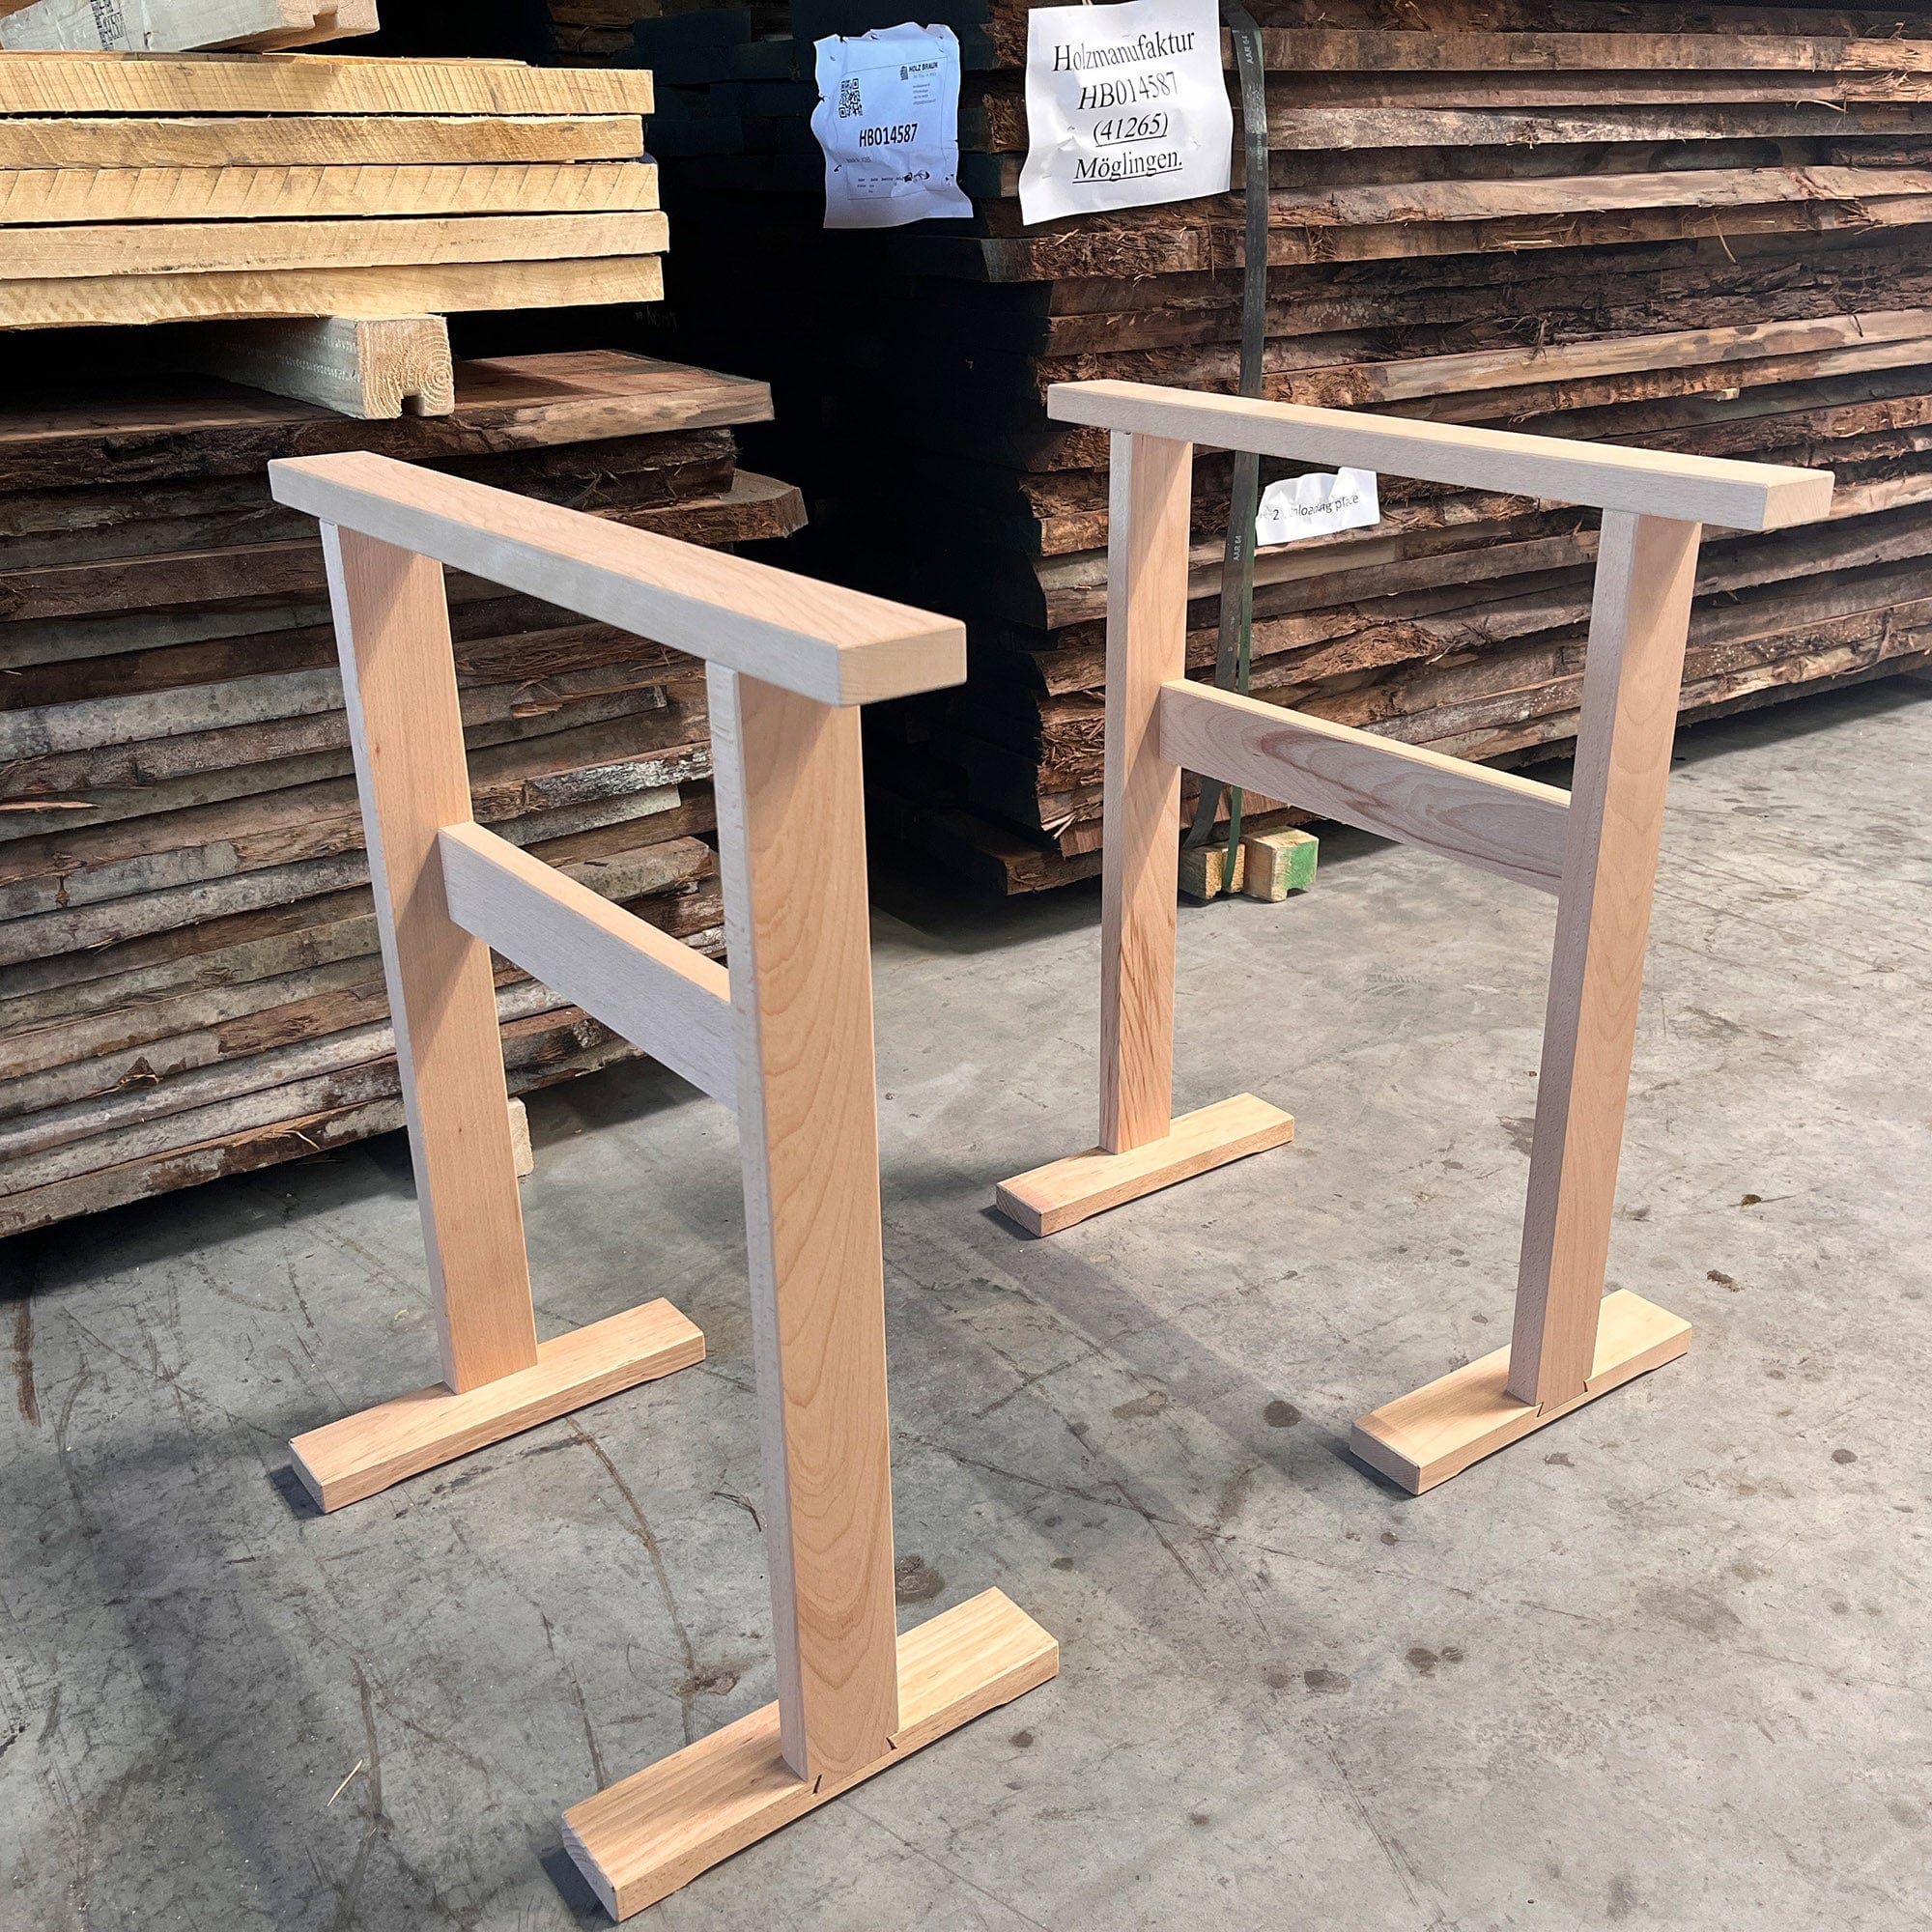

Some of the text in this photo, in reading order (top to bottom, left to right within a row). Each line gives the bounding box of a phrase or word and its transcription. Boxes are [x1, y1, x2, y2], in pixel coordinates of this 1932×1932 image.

[1051, 30, 1195, 72] Holzmanufaktur
[1076, 71, 1179, 110] HB014587
[1093, 111, 1169, 145] (41265)
[1072, 151, 1183, 183] Möglingen.
[1290, 501, 1333, 518] nloading
